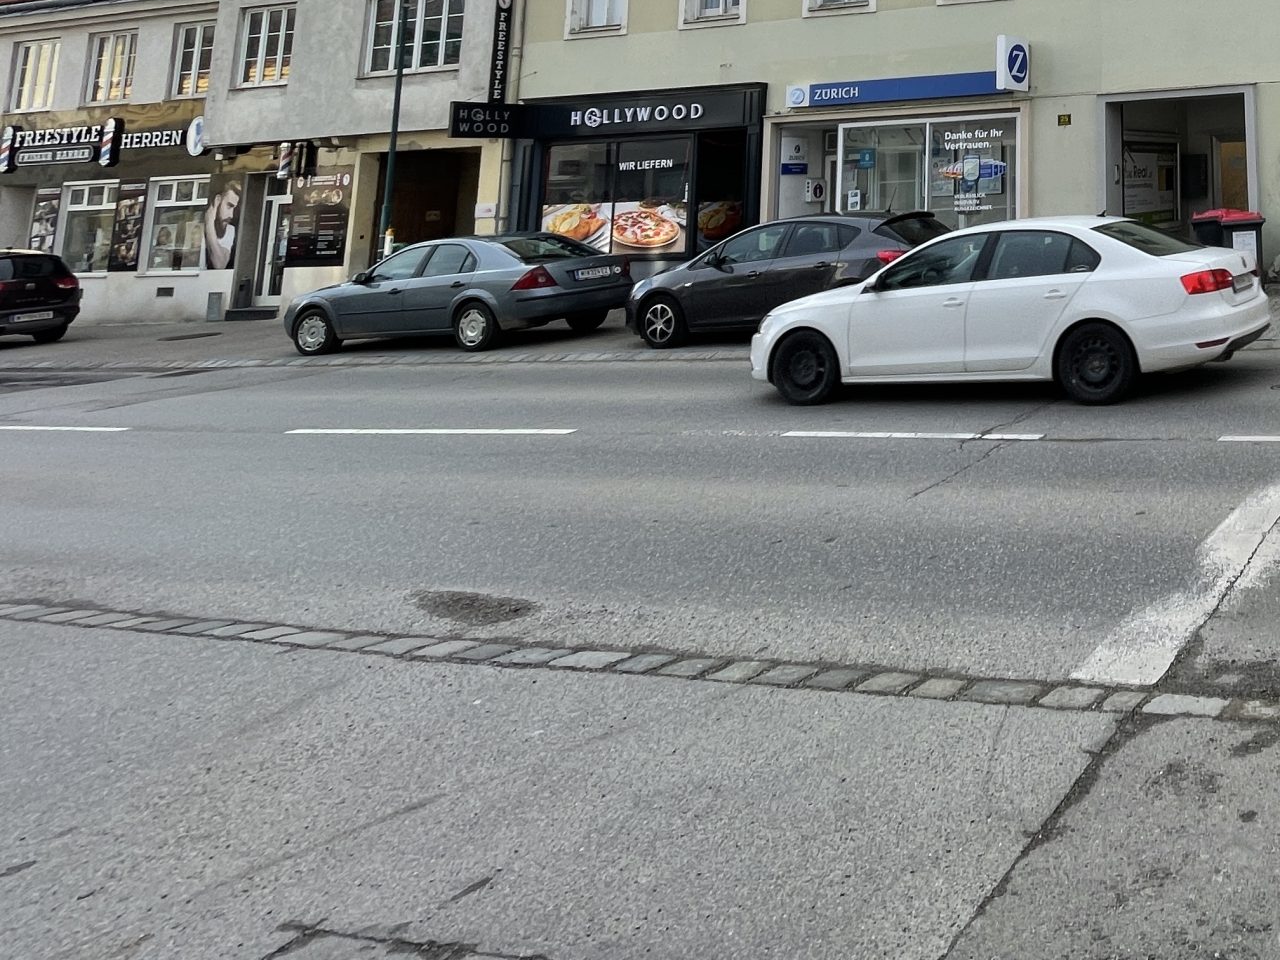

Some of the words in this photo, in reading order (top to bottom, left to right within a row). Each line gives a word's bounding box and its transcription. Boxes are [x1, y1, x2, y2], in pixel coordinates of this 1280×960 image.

[492, 12, 507, 99] FREESTYLE
[570, 103, 704, 127] HOLLYWOOD
[459, 123, 509, 133] WOOD
[944, 130, 973, 140] Danke
[974, 129, 989, 139] für
[990, 128, 1004, 138] Ihr
[14, 126, 101, 147] FREESTYLE
[120, 130, 183, 149] HERREN
[944, 141, 992, 151] Vertrauen.
[618, 161, 636, 171] WIR
[637, 159, 673, 170] LIEFERN
